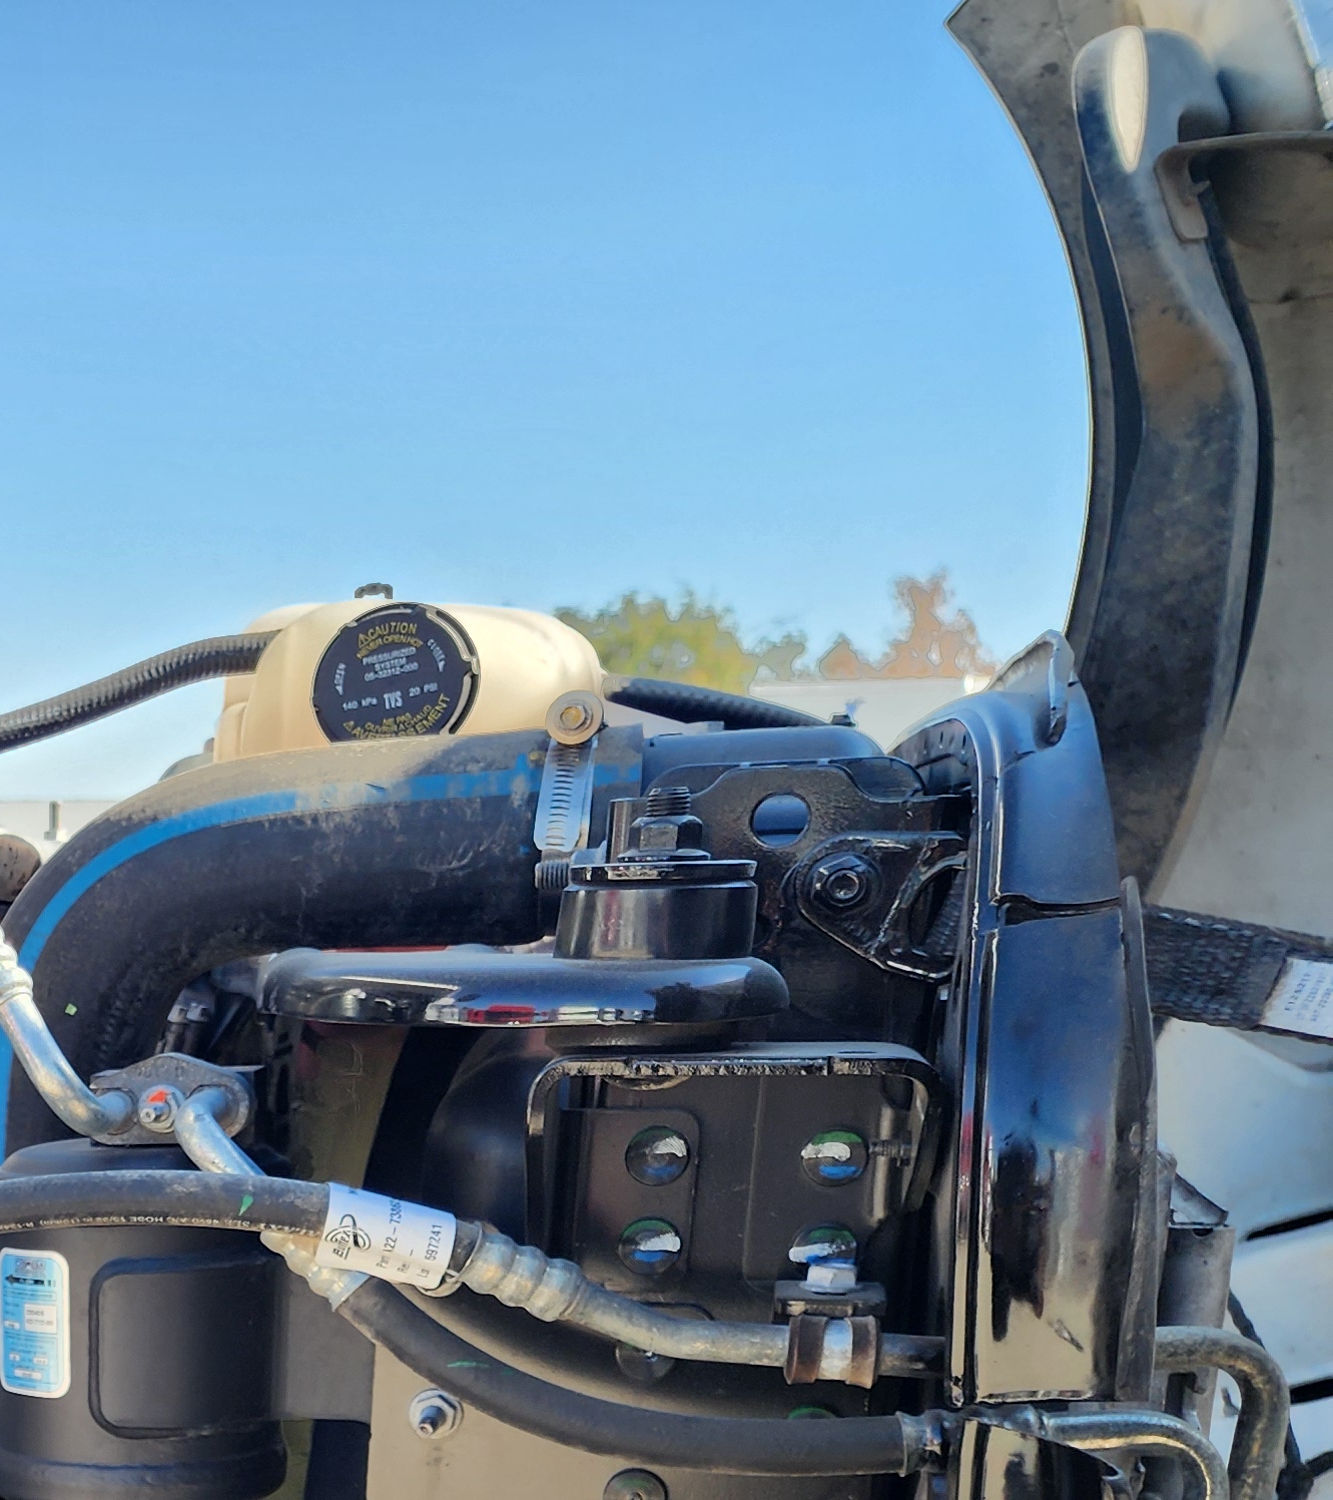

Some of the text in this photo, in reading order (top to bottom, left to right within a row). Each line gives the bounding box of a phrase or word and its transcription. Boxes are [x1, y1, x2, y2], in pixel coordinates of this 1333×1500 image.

[368, 622, 418, 638] CAUTION
[356, 638, 382, 659] NEVER
[383, 634, 406, 644] OPEN
[362, 646, 417, 666] PRESSURIZED
[374, 657, 407, 672] SYSTEM
[409, 682, 438, 697] 20 PSI
[342, 700, 359, 711] 140
[383, 691, 403, 710] TVS
[130, 1215, 164, 1223] HOSE
